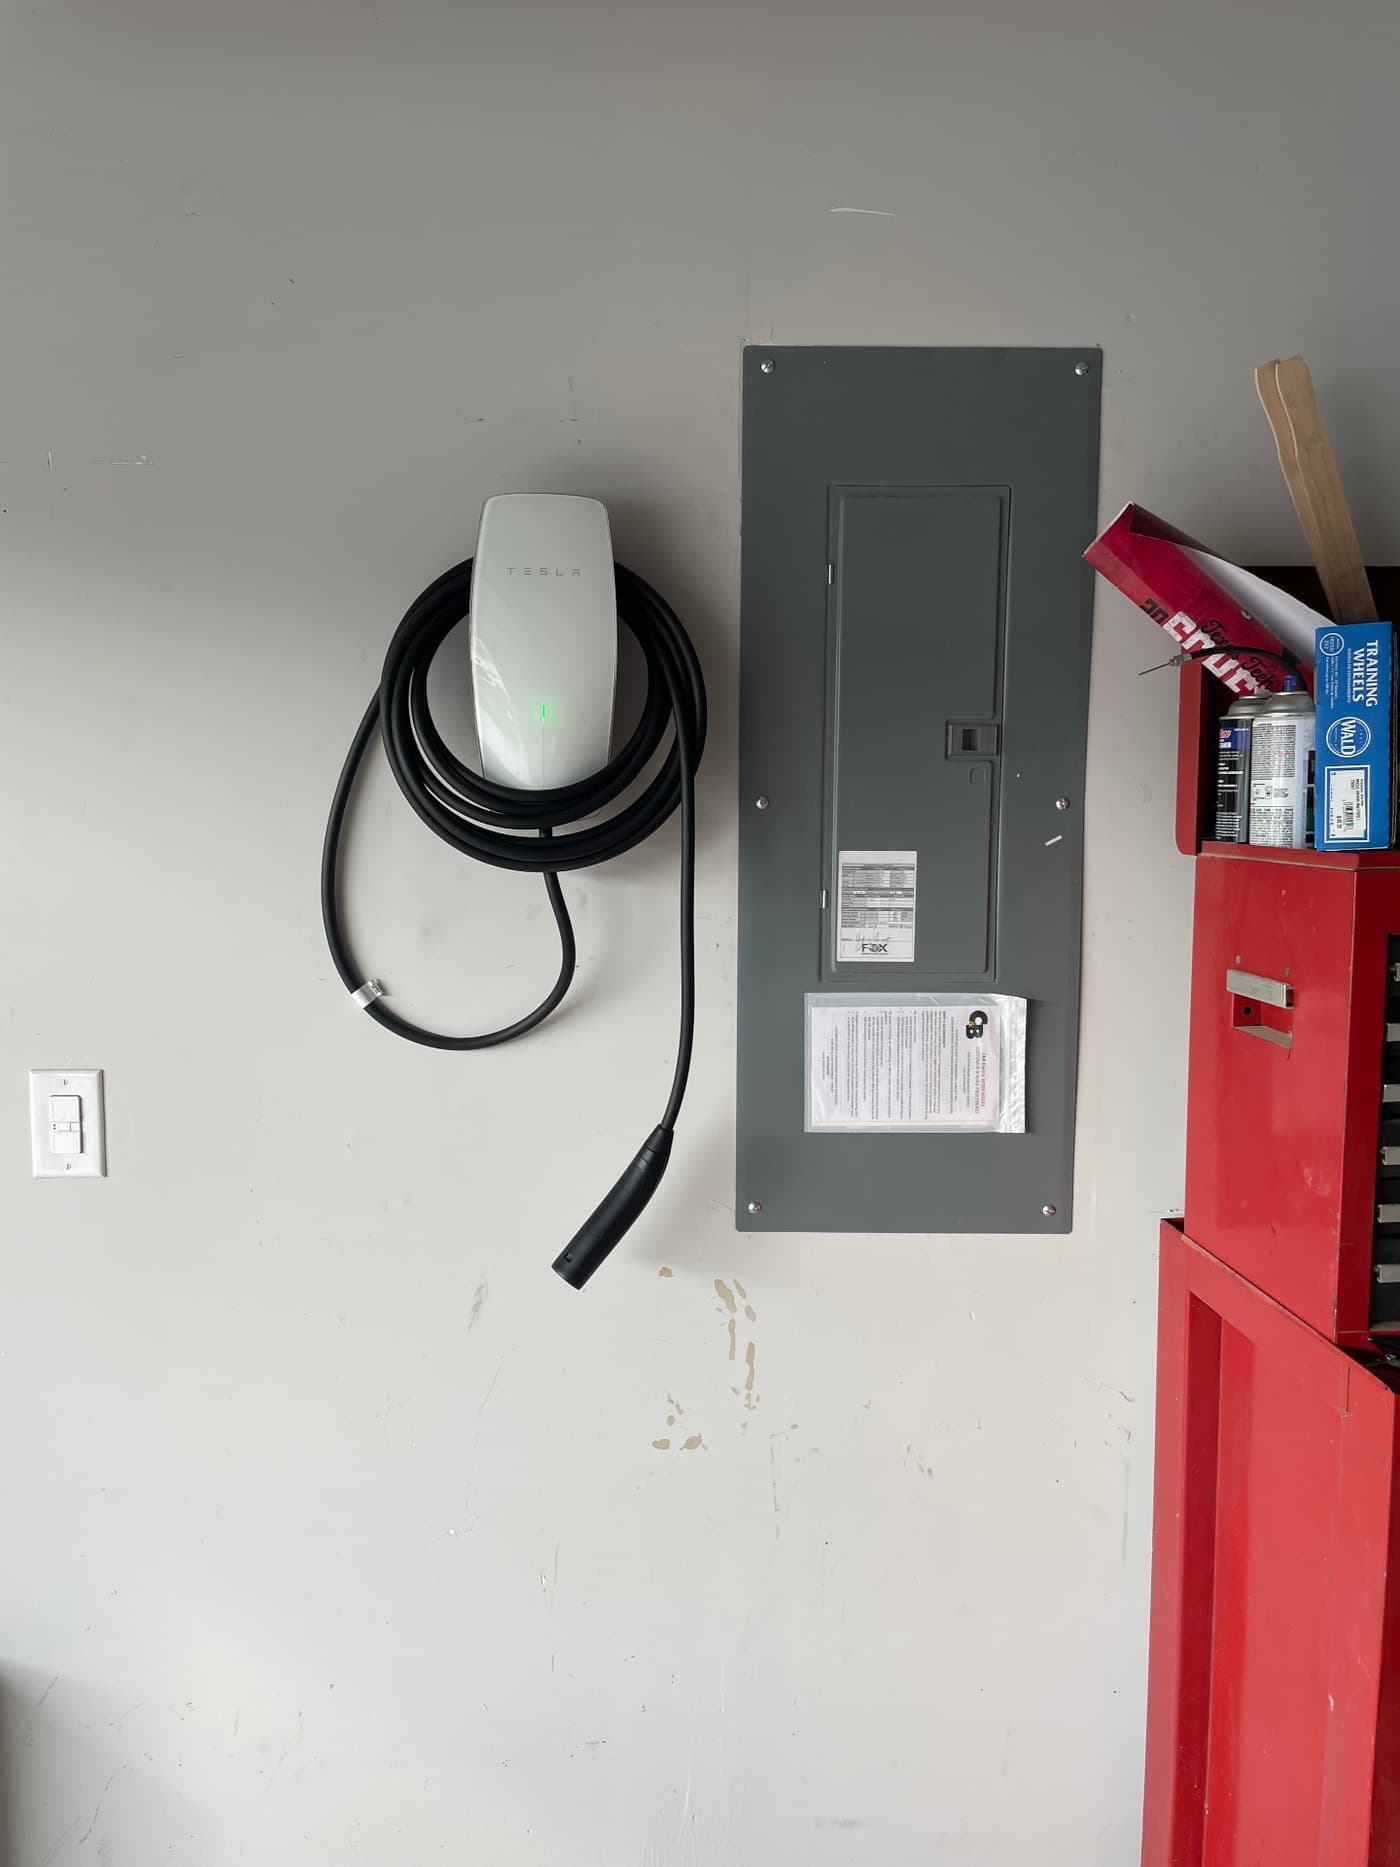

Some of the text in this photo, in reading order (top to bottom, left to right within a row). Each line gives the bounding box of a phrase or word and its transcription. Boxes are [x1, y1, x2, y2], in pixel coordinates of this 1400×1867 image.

[506, 567, 581, 577] TESLA
[1352, 648, 1365, 702] WHEELS
[1365, 640, 1378, 707] TRAINING
[1340, 720, 1356, 755] WALD
